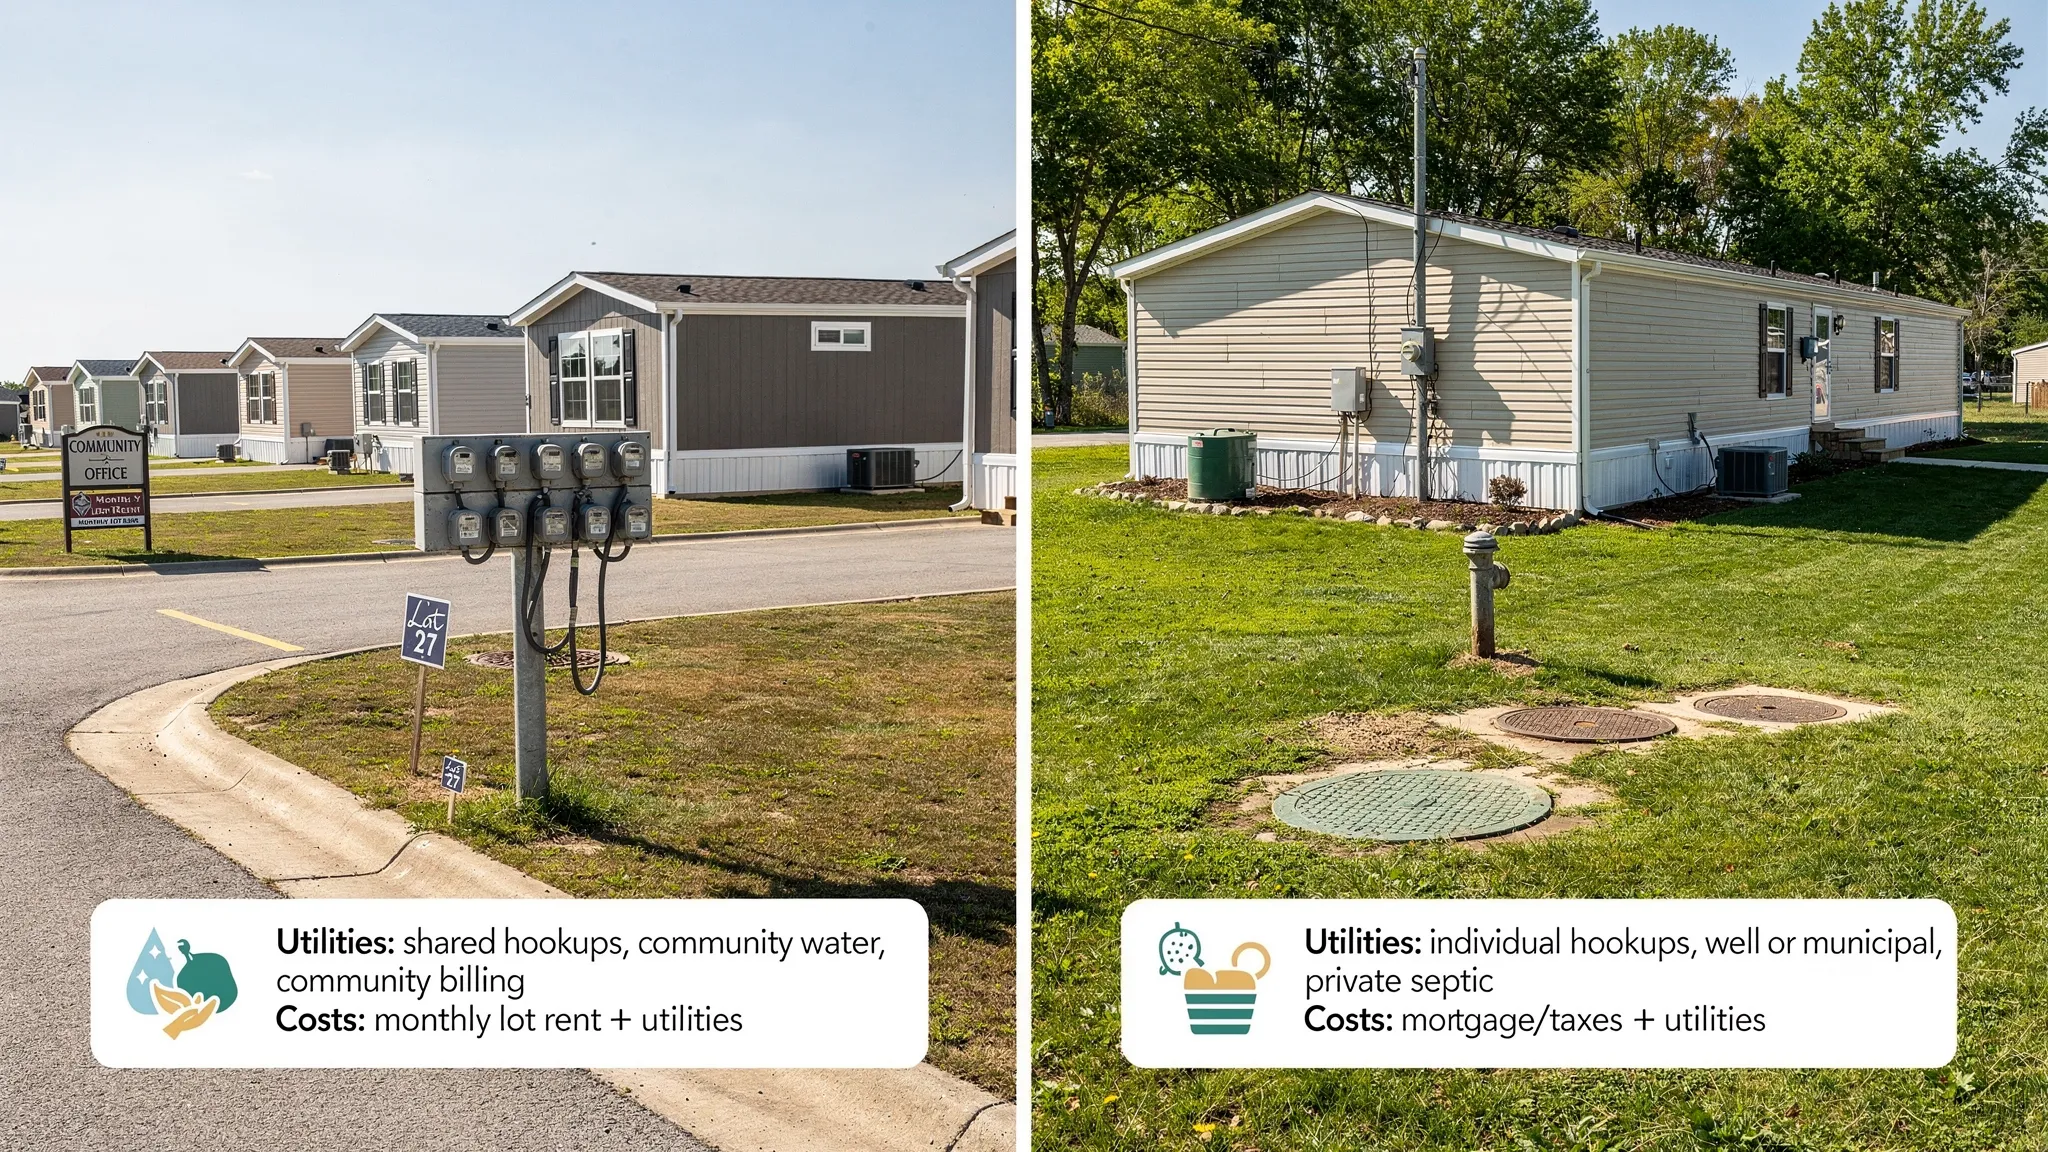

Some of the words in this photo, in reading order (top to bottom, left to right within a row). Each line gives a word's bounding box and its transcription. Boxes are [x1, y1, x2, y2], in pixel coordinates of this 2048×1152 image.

[69, 439, 141, 453] COMMUNITY
[84, 466, 128, 480] OFFICE
[413, 629, 438, 657] 27
[444, 772, 461, 789] 27
